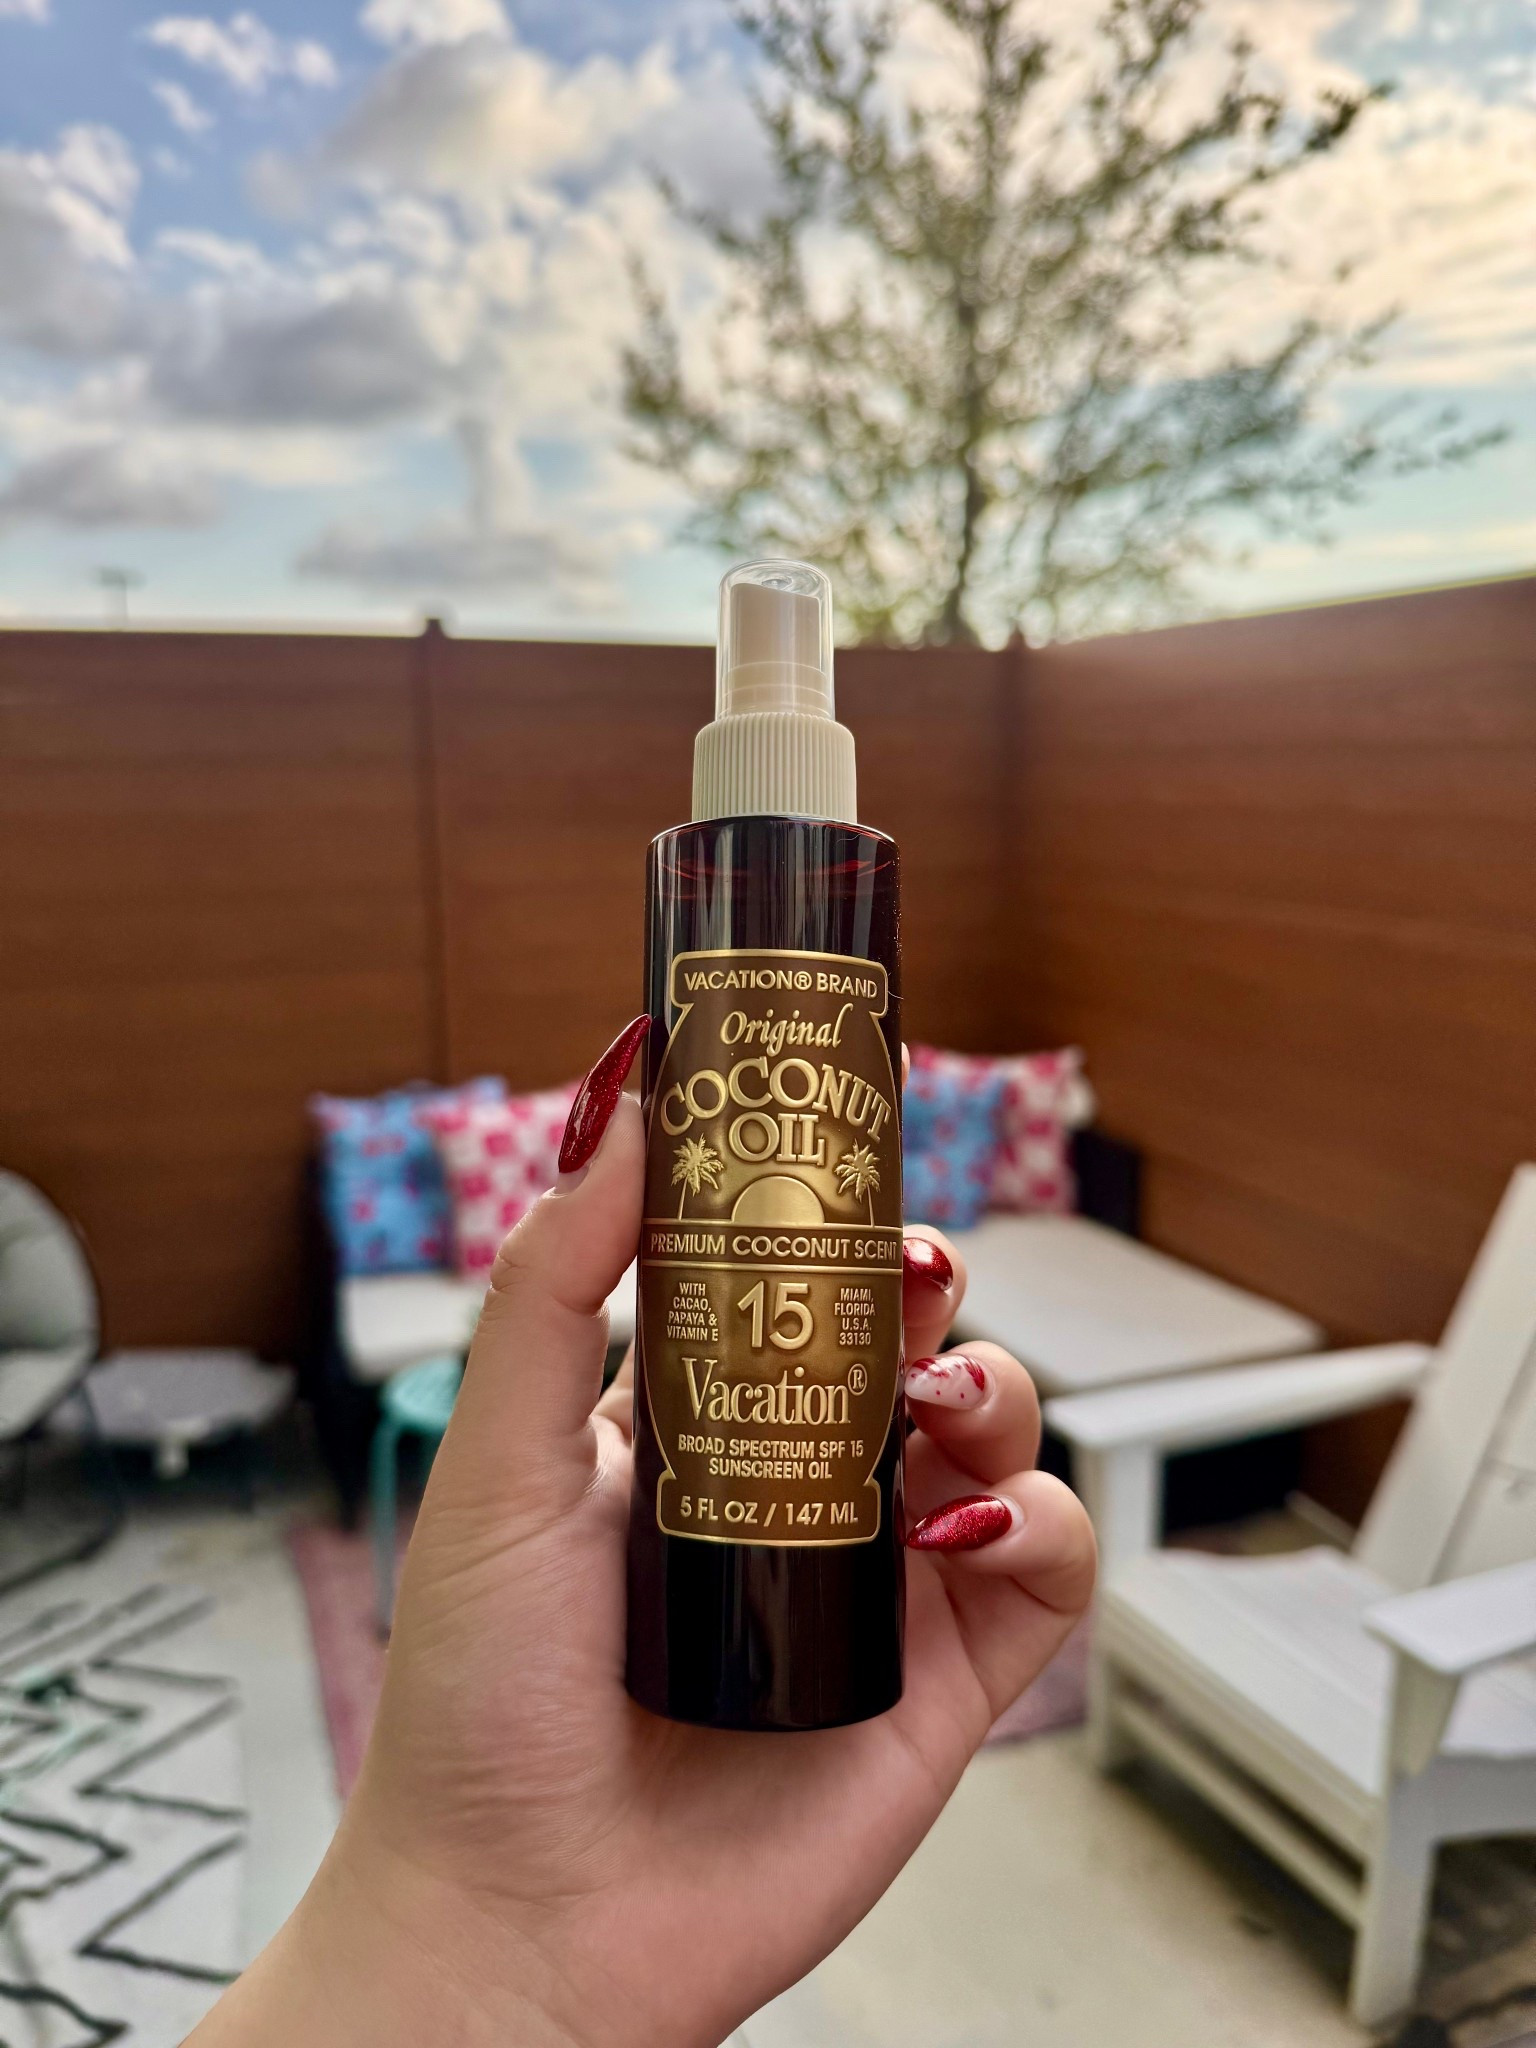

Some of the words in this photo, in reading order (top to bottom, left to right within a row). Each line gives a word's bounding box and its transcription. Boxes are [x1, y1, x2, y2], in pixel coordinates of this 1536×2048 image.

[816, 972, 878, 998] BRAND
[719, 1002, 854, 1057] Original
[660, 1056, 891, 1142] COCONUT
[728, 1111, 825, 1166] OIL
[650, 1233, 726, 1255] PREMIUM
[732, 1235, 850, 1259] COCONUT
[854, 1239, 898, 1261] SCENT
[679, 1282, 706, 1296] WITH
[840, 1287, 874, 1302] MIAMI,
[673, 1297, 712, 1313] CACAO,
[737, 1280, 814, 1350] 15
[834, 1302, 876, 1316] FLORIDA
[668, 1310, 705, 1326] PAPAYA
[708, 1313, 718, 1327] &
[666, 1325, 708, 1341] VITAMIN
[712, 1328, 719, 1342] E
[839, 1332, 871, 1346] 33130
[678, 1433, 725, 1455] BROAD
[729, 1439, 815, 1459] SPECTRUM
[819, 1440, 846, 1459] SPF
[850, 1440, 864, 1458] 15
[709, 1457, 804, 1480] SUNSCREEN
[808, 1461, 833, 1480] OIL
[680, 1496, 692, 1518] 5
[697, 1498, 719, 1521] FL
[724, 1500, 758, 1524] OZ
[763, 1503, 777, 1527] /
[785, 1502, 824, 1525] 147
[830, 1502, 858, 1525] ML
